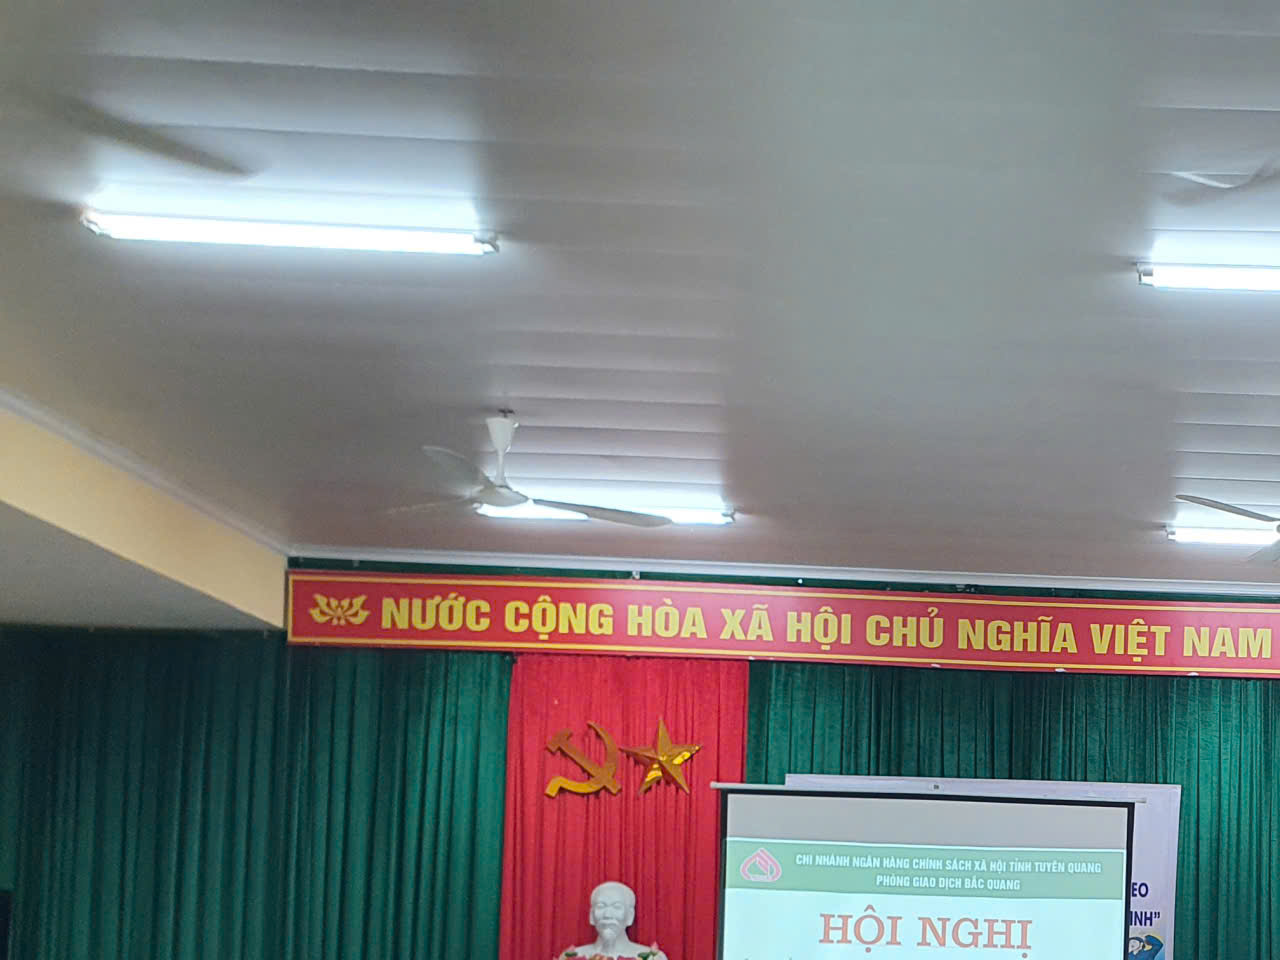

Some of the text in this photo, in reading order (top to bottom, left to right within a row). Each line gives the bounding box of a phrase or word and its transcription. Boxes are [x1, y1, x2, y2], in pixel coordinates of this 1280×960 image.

[381, 592, 491, 631] NƯỚC
[504, 595, 614, 640] CỘNG
[627, 598, 708, 639] HÒA
[719, 604, 774, 641] XÃ
[786, 606, 852, 650] HỘI
[866, 606, 944, 648] CHỦ
[957, 615, 1078, 653] NGHĨA
[1090, 618, 1171, 662] VIỆT
[1183, 626, 1272, 658] NAM
[796, 854, 813, 865] CHI
[945, 858, 972, 871] SÁCH
[1067, 862, 1102, 874] QUANG
[912, 876, 936, 888] GIAO
[938, 878, 962, 890] DỊCH
[987, 879, 1021, 890] QUANG
[819, 904, 1032, 959] HỘI NGHỊ
